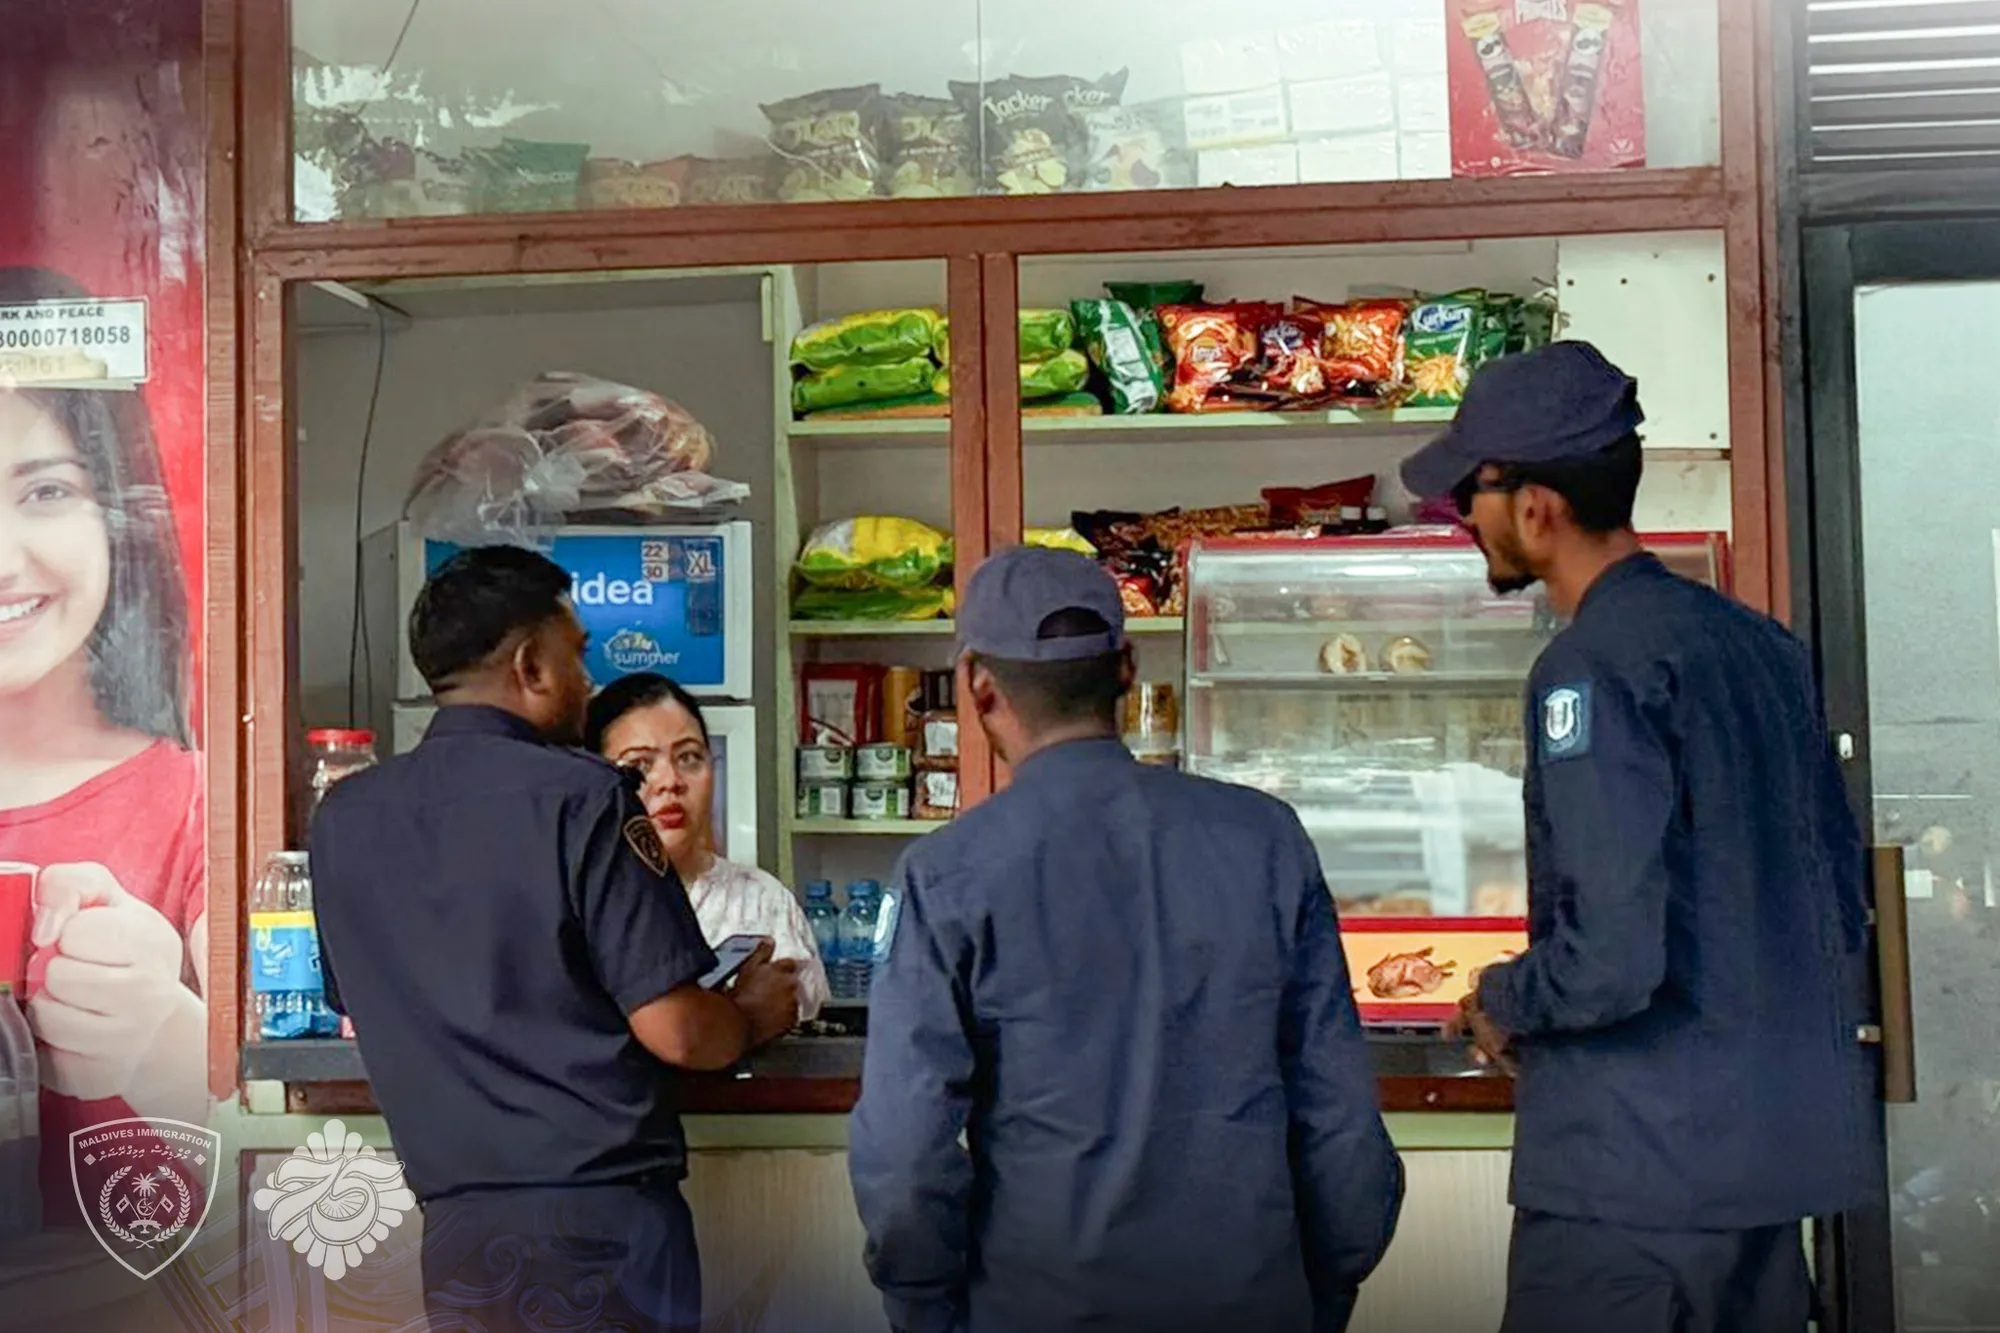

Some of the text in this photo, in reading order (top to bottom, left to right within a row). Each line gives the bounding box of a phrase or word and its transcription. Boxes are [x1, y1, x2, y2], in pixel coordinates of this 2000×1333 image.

[982, 88, 1054, 124] Jacker
[1063, 85, 1111, 106] cker
[24, 308, 54, 320] AND
[58, 306, 104, 318] PEACE
[686, 550, 716, 578] XL
[570, 571, 653, 605] idea
[614, 652, 680, 665] summer
